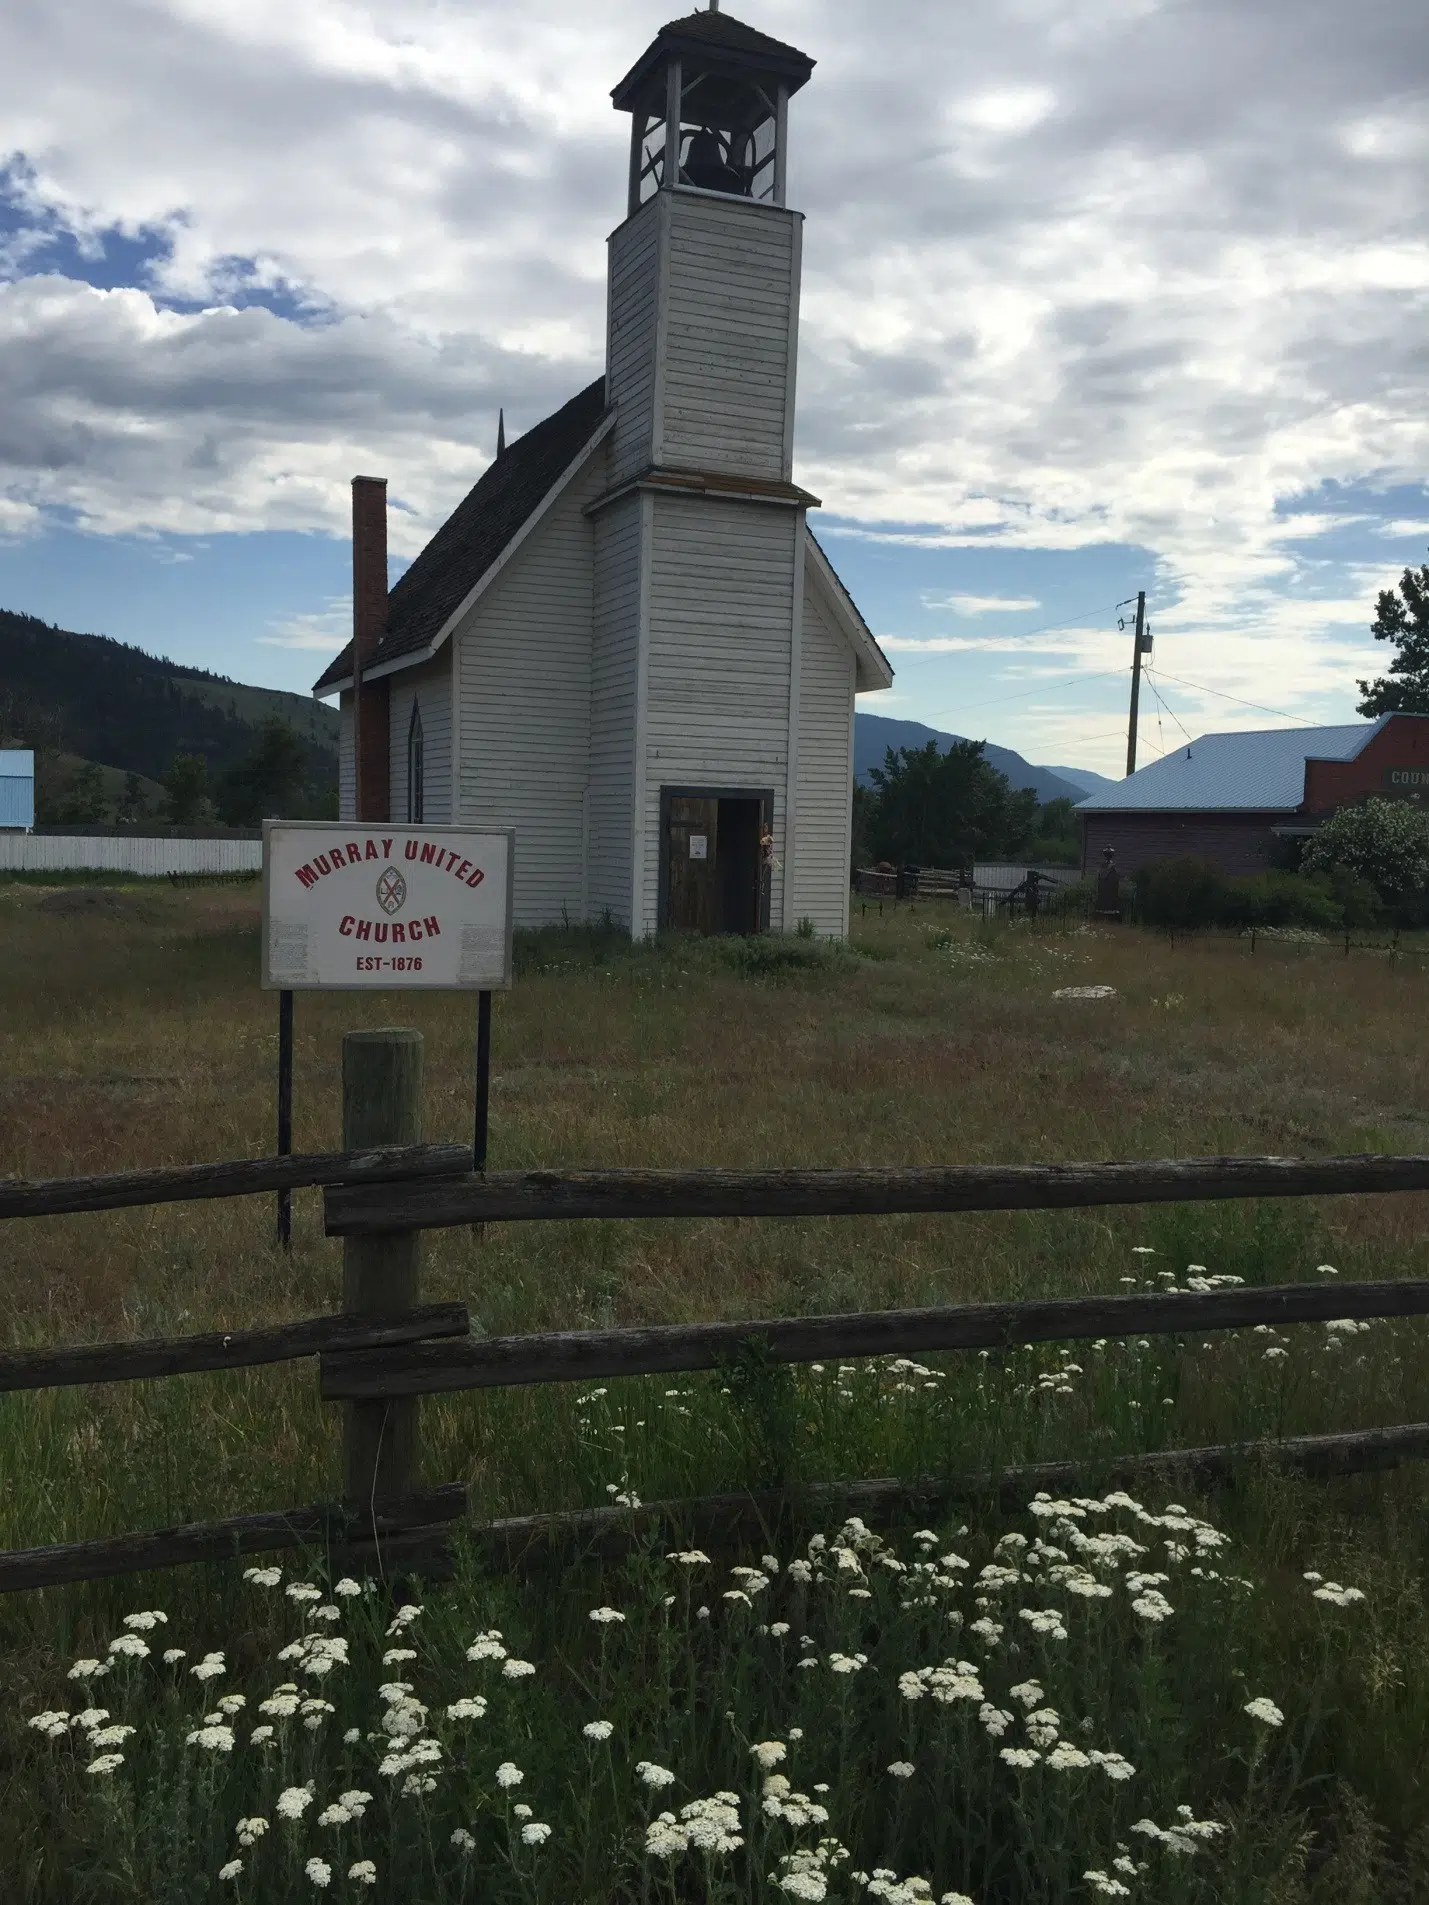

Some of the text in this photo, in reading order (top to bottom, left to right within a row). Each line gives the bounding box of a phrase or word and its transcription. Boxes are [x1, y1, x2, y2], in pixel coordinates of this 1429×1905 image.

[294, 839, 485, 889] MURRAY UNITED
[338, 915, 441, 943] CHURCH
[356, 956, 423, 971] EST-1876
